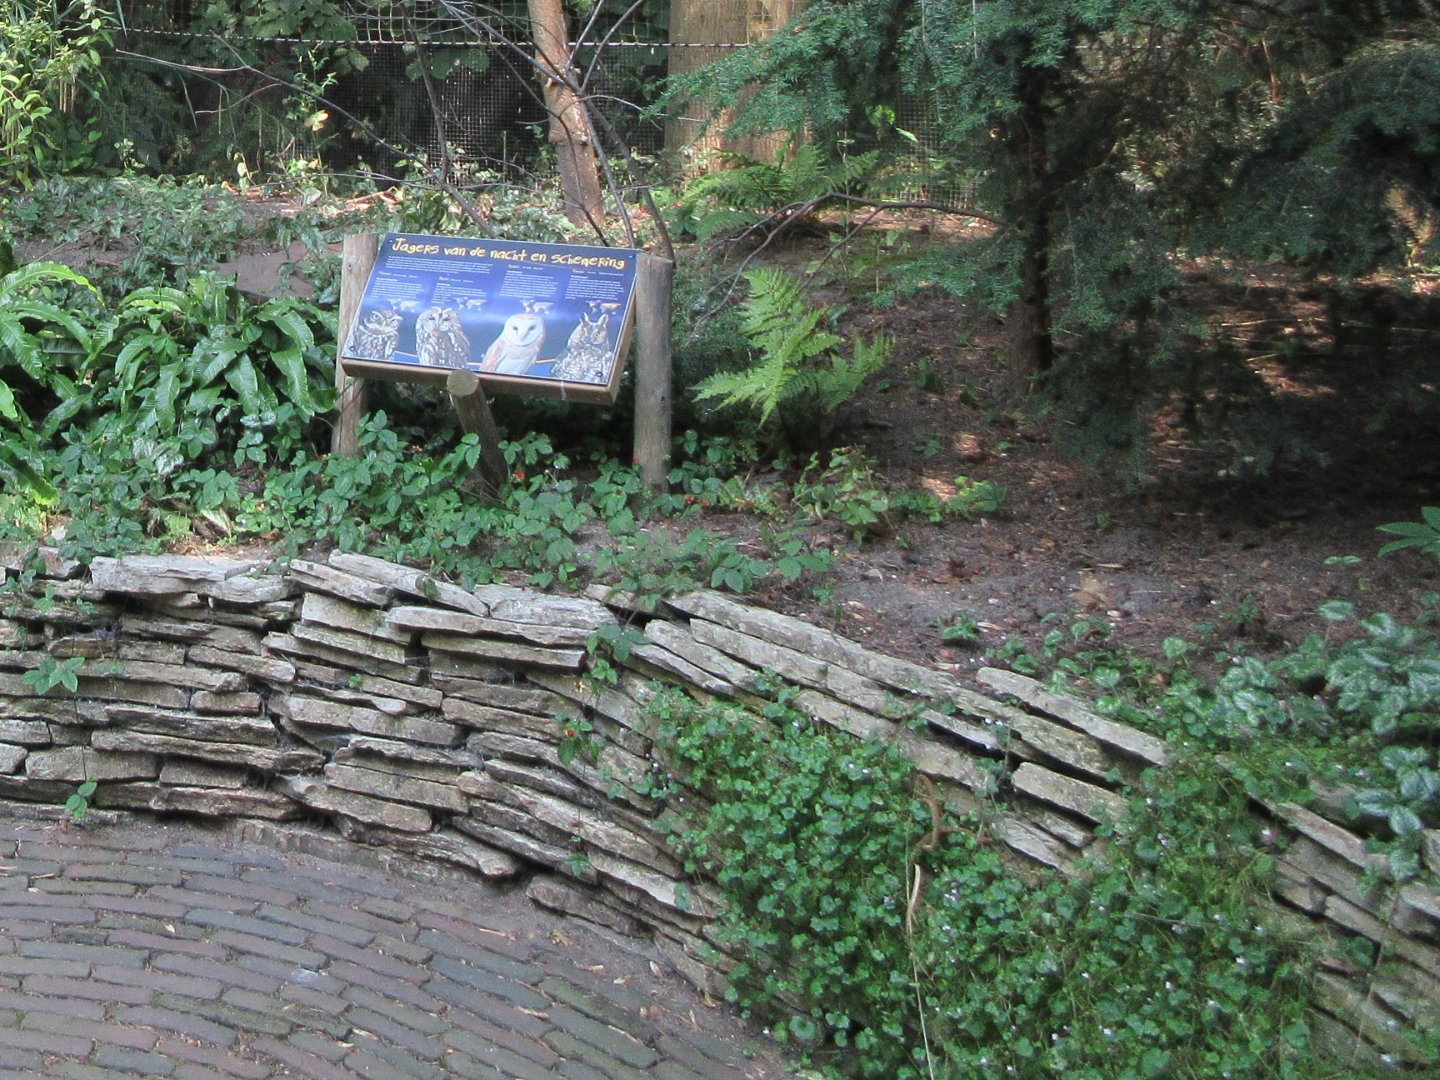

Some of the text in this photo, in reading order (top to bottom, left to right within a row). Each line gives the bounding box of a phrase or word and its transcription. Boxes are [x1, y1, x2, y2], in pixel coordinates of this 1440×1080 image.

[444, 247, 466, 256] van
[469, 247, 486, 257] de
[530, 252, 547, 262] en
